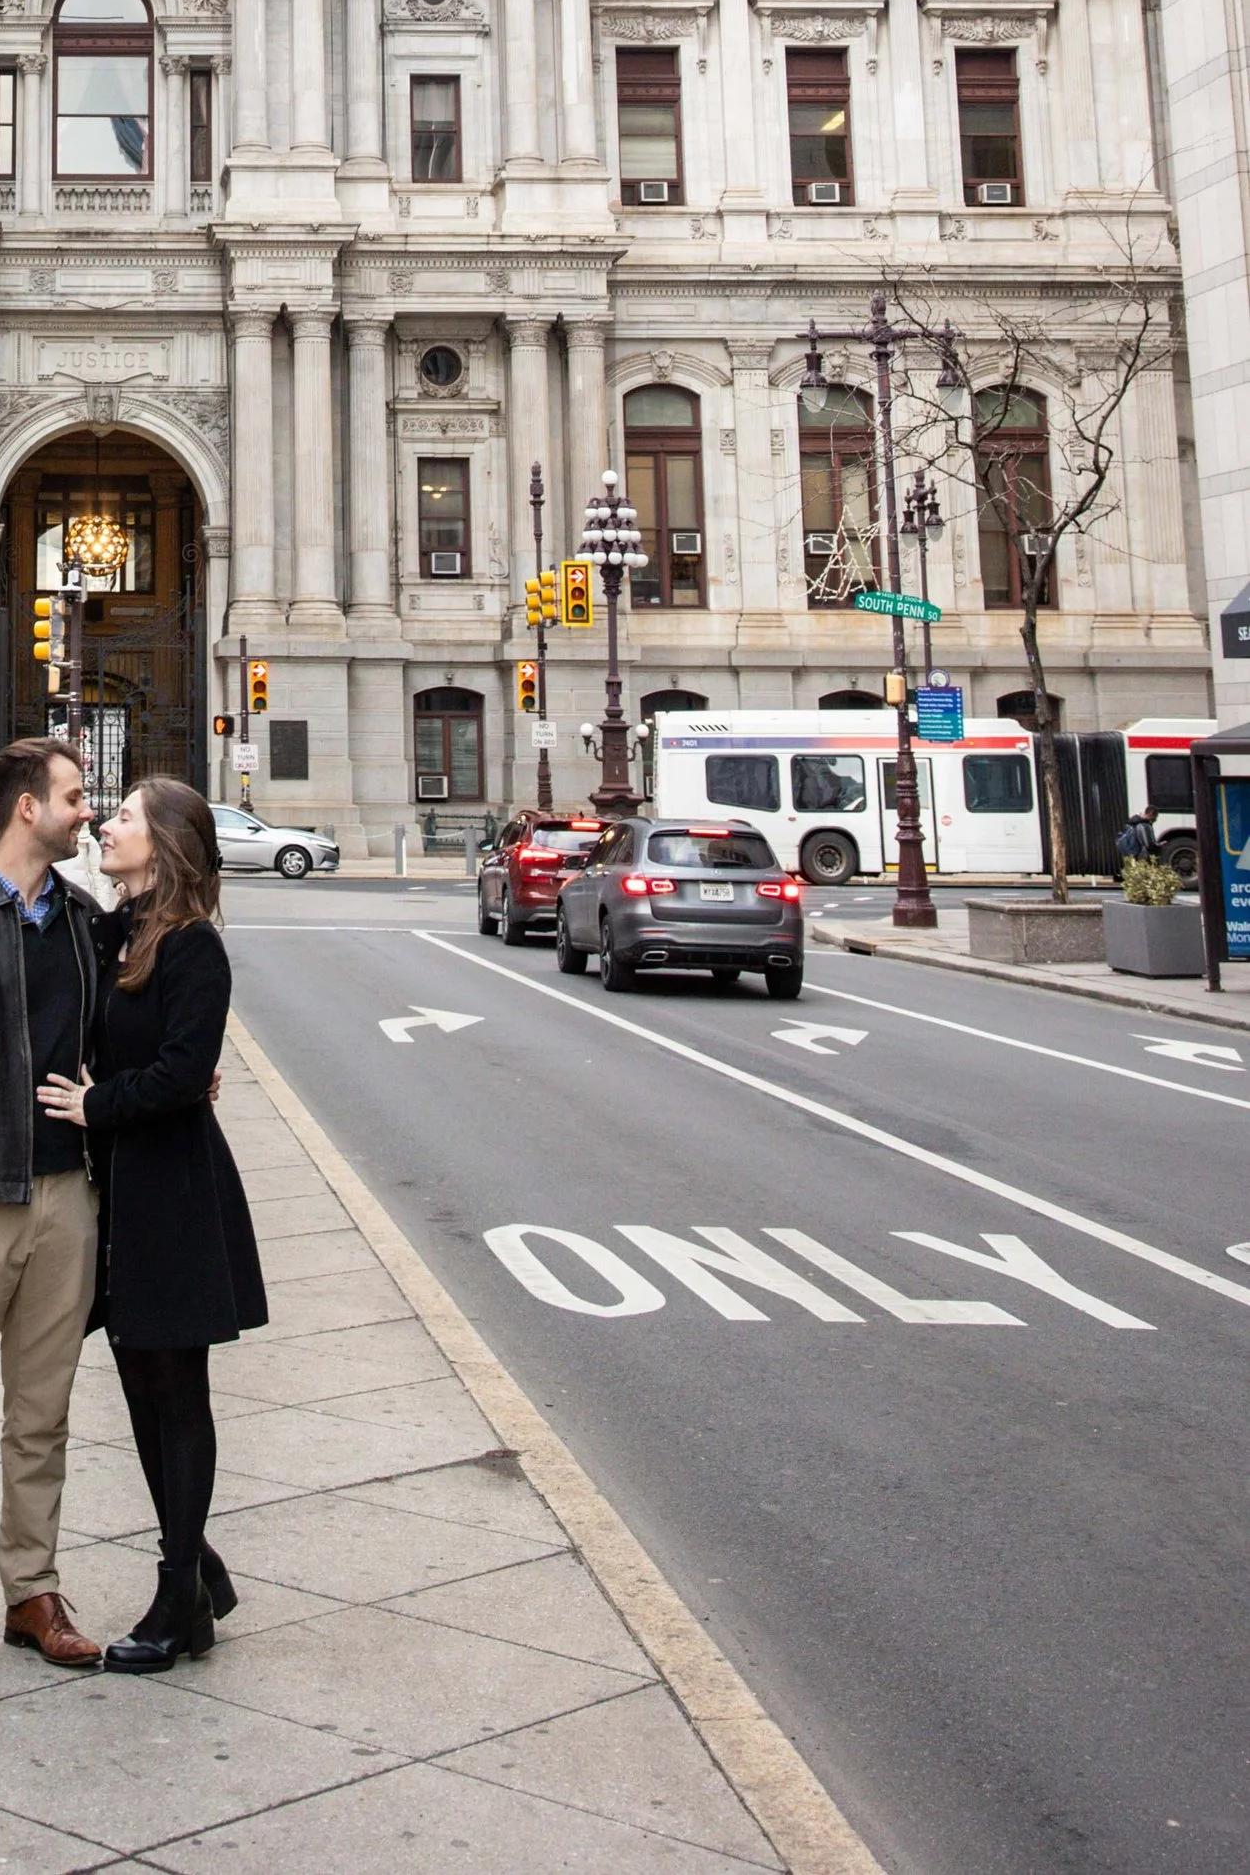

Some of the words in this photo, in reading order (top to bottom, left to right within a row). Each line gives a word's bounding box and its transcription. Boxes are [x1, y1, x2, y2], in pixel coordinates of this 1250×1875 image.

[56, 351, 149, 368] JUSTICE
[858, 596, 894, 612] SOUTH
[897, 602, 925, 618] PENN
[927, 611, 938, 621] SQ
[1237, 625, 1250, 641] SE
[483, 1224, 1158, 1330] ONLY
